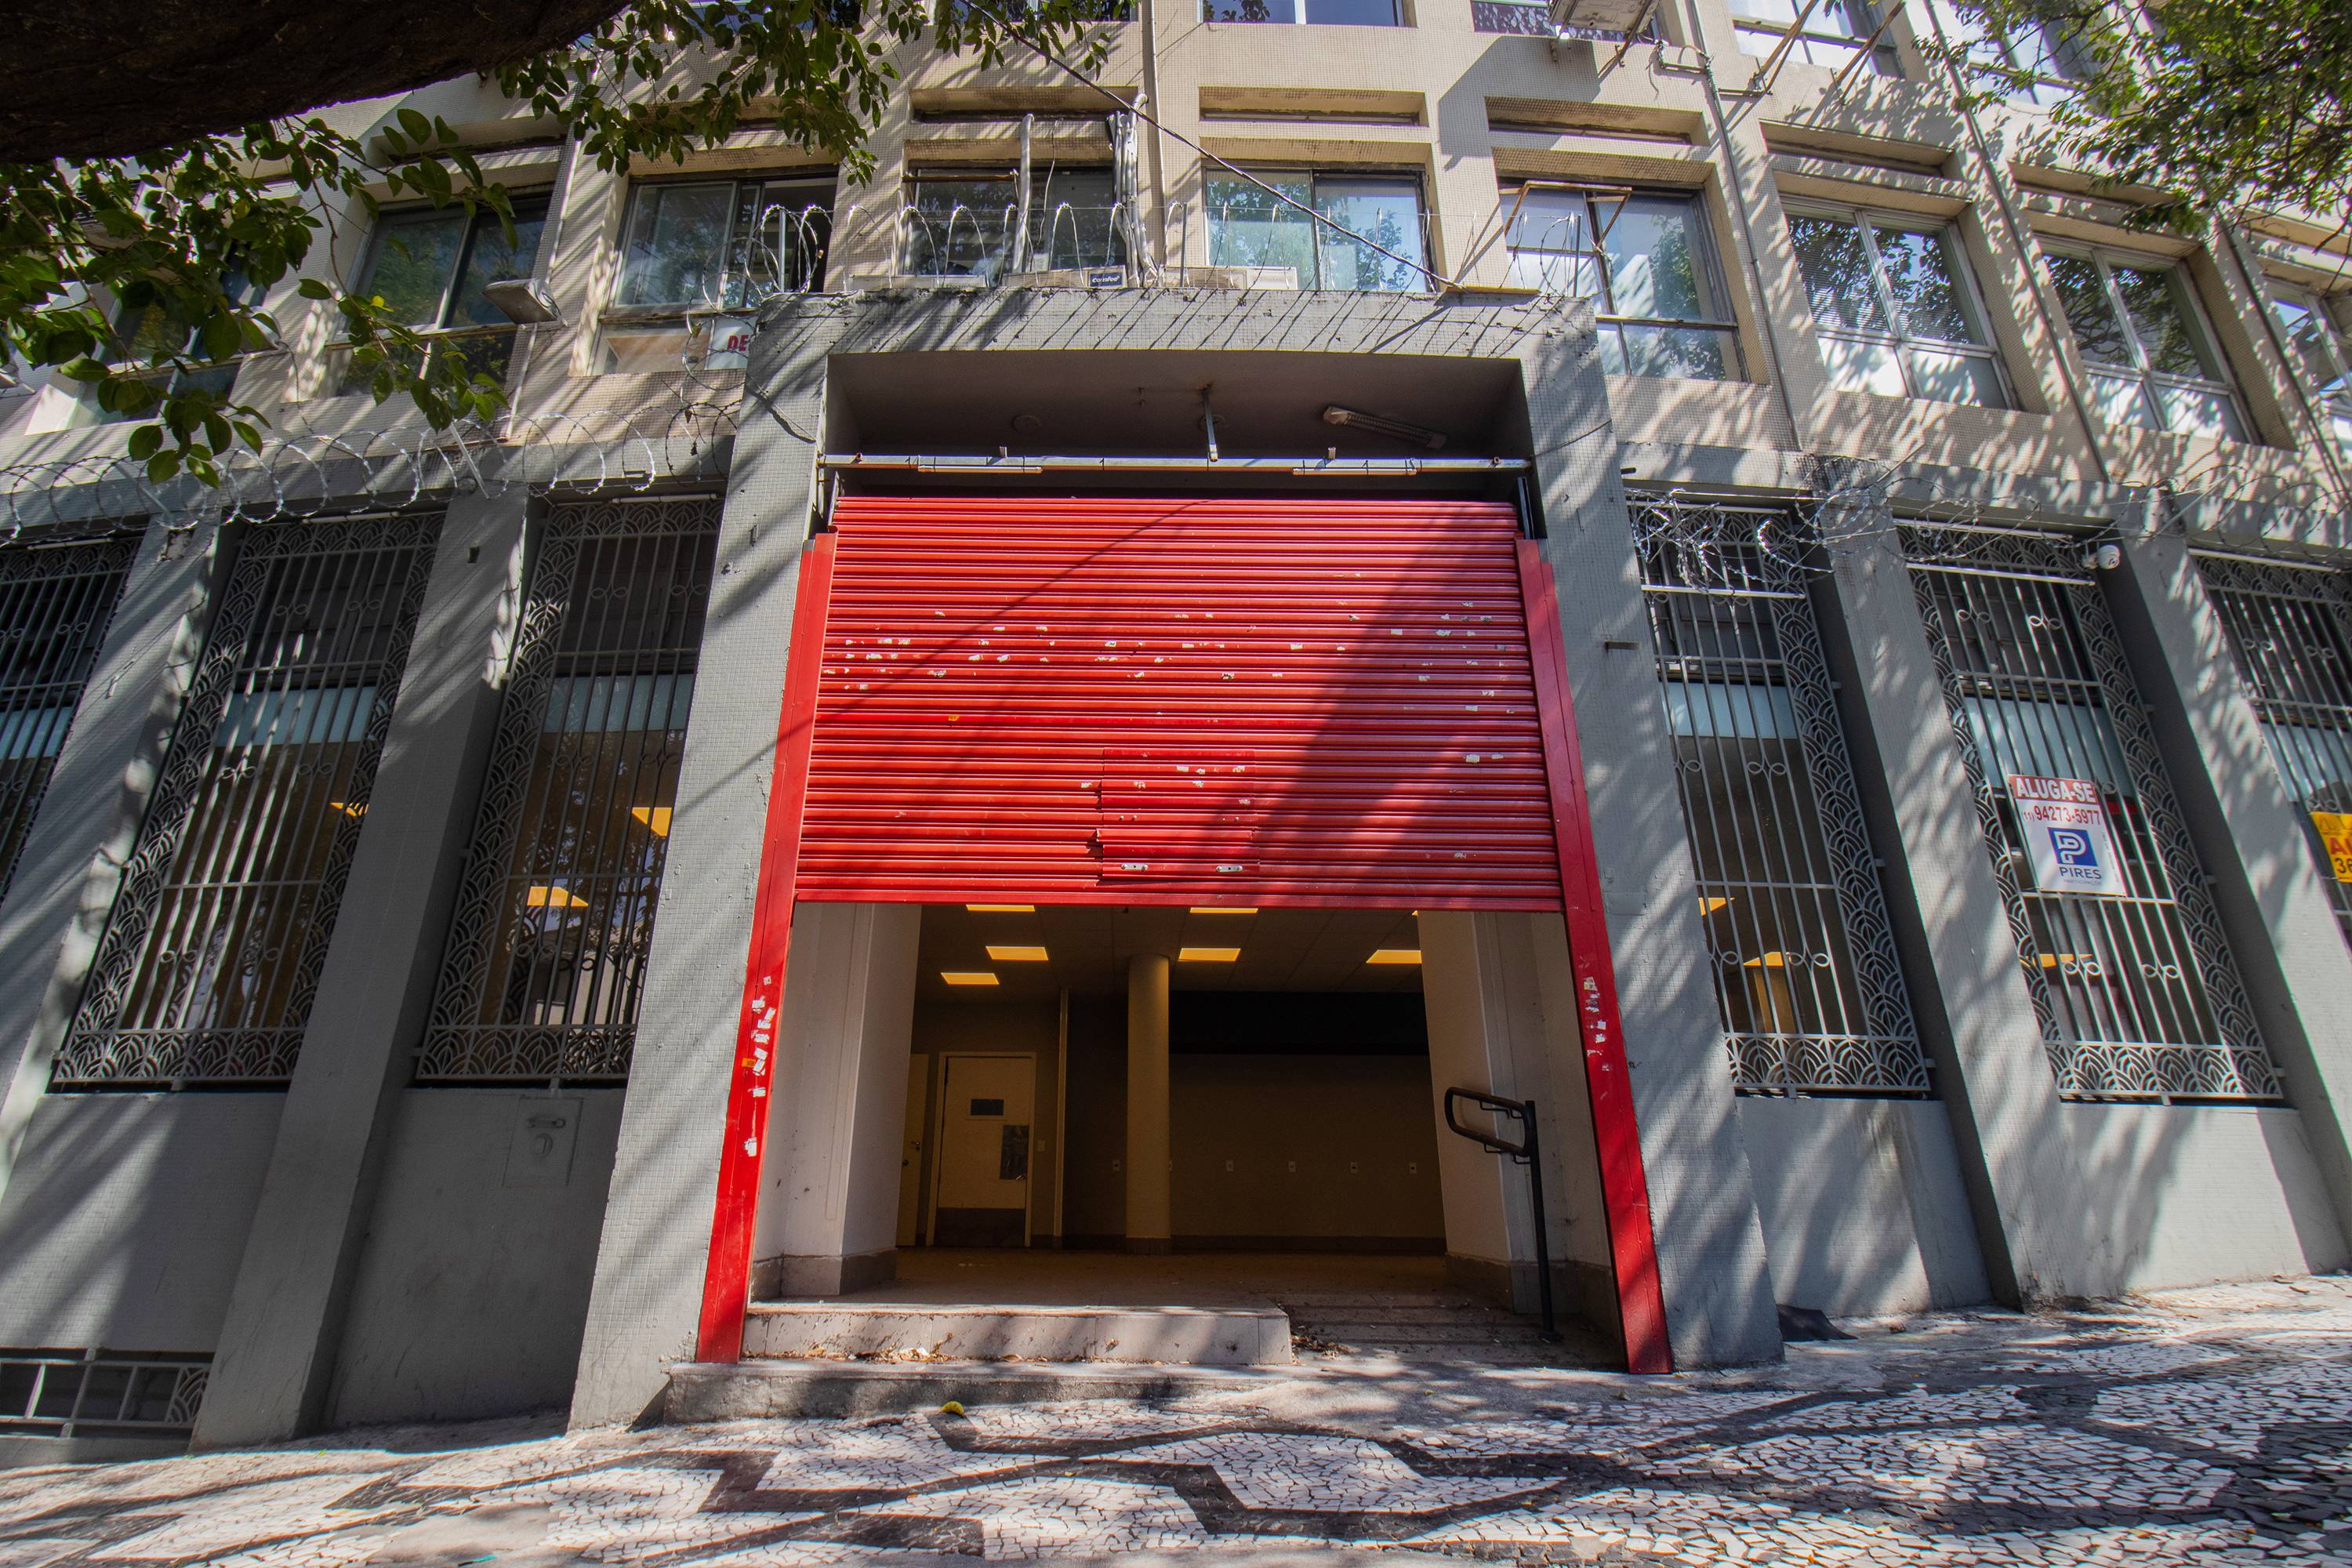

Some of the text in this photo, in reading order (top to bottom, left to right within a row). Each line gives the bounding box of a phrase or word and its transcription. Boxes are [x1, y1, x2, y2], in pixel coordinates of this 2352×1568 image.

[2016, 777, 2096, 803] ALUGA-SE
[2020, 805, 2100, 826] (11) 94273-5977
[2059, 866, 2102, 880] PIRES
